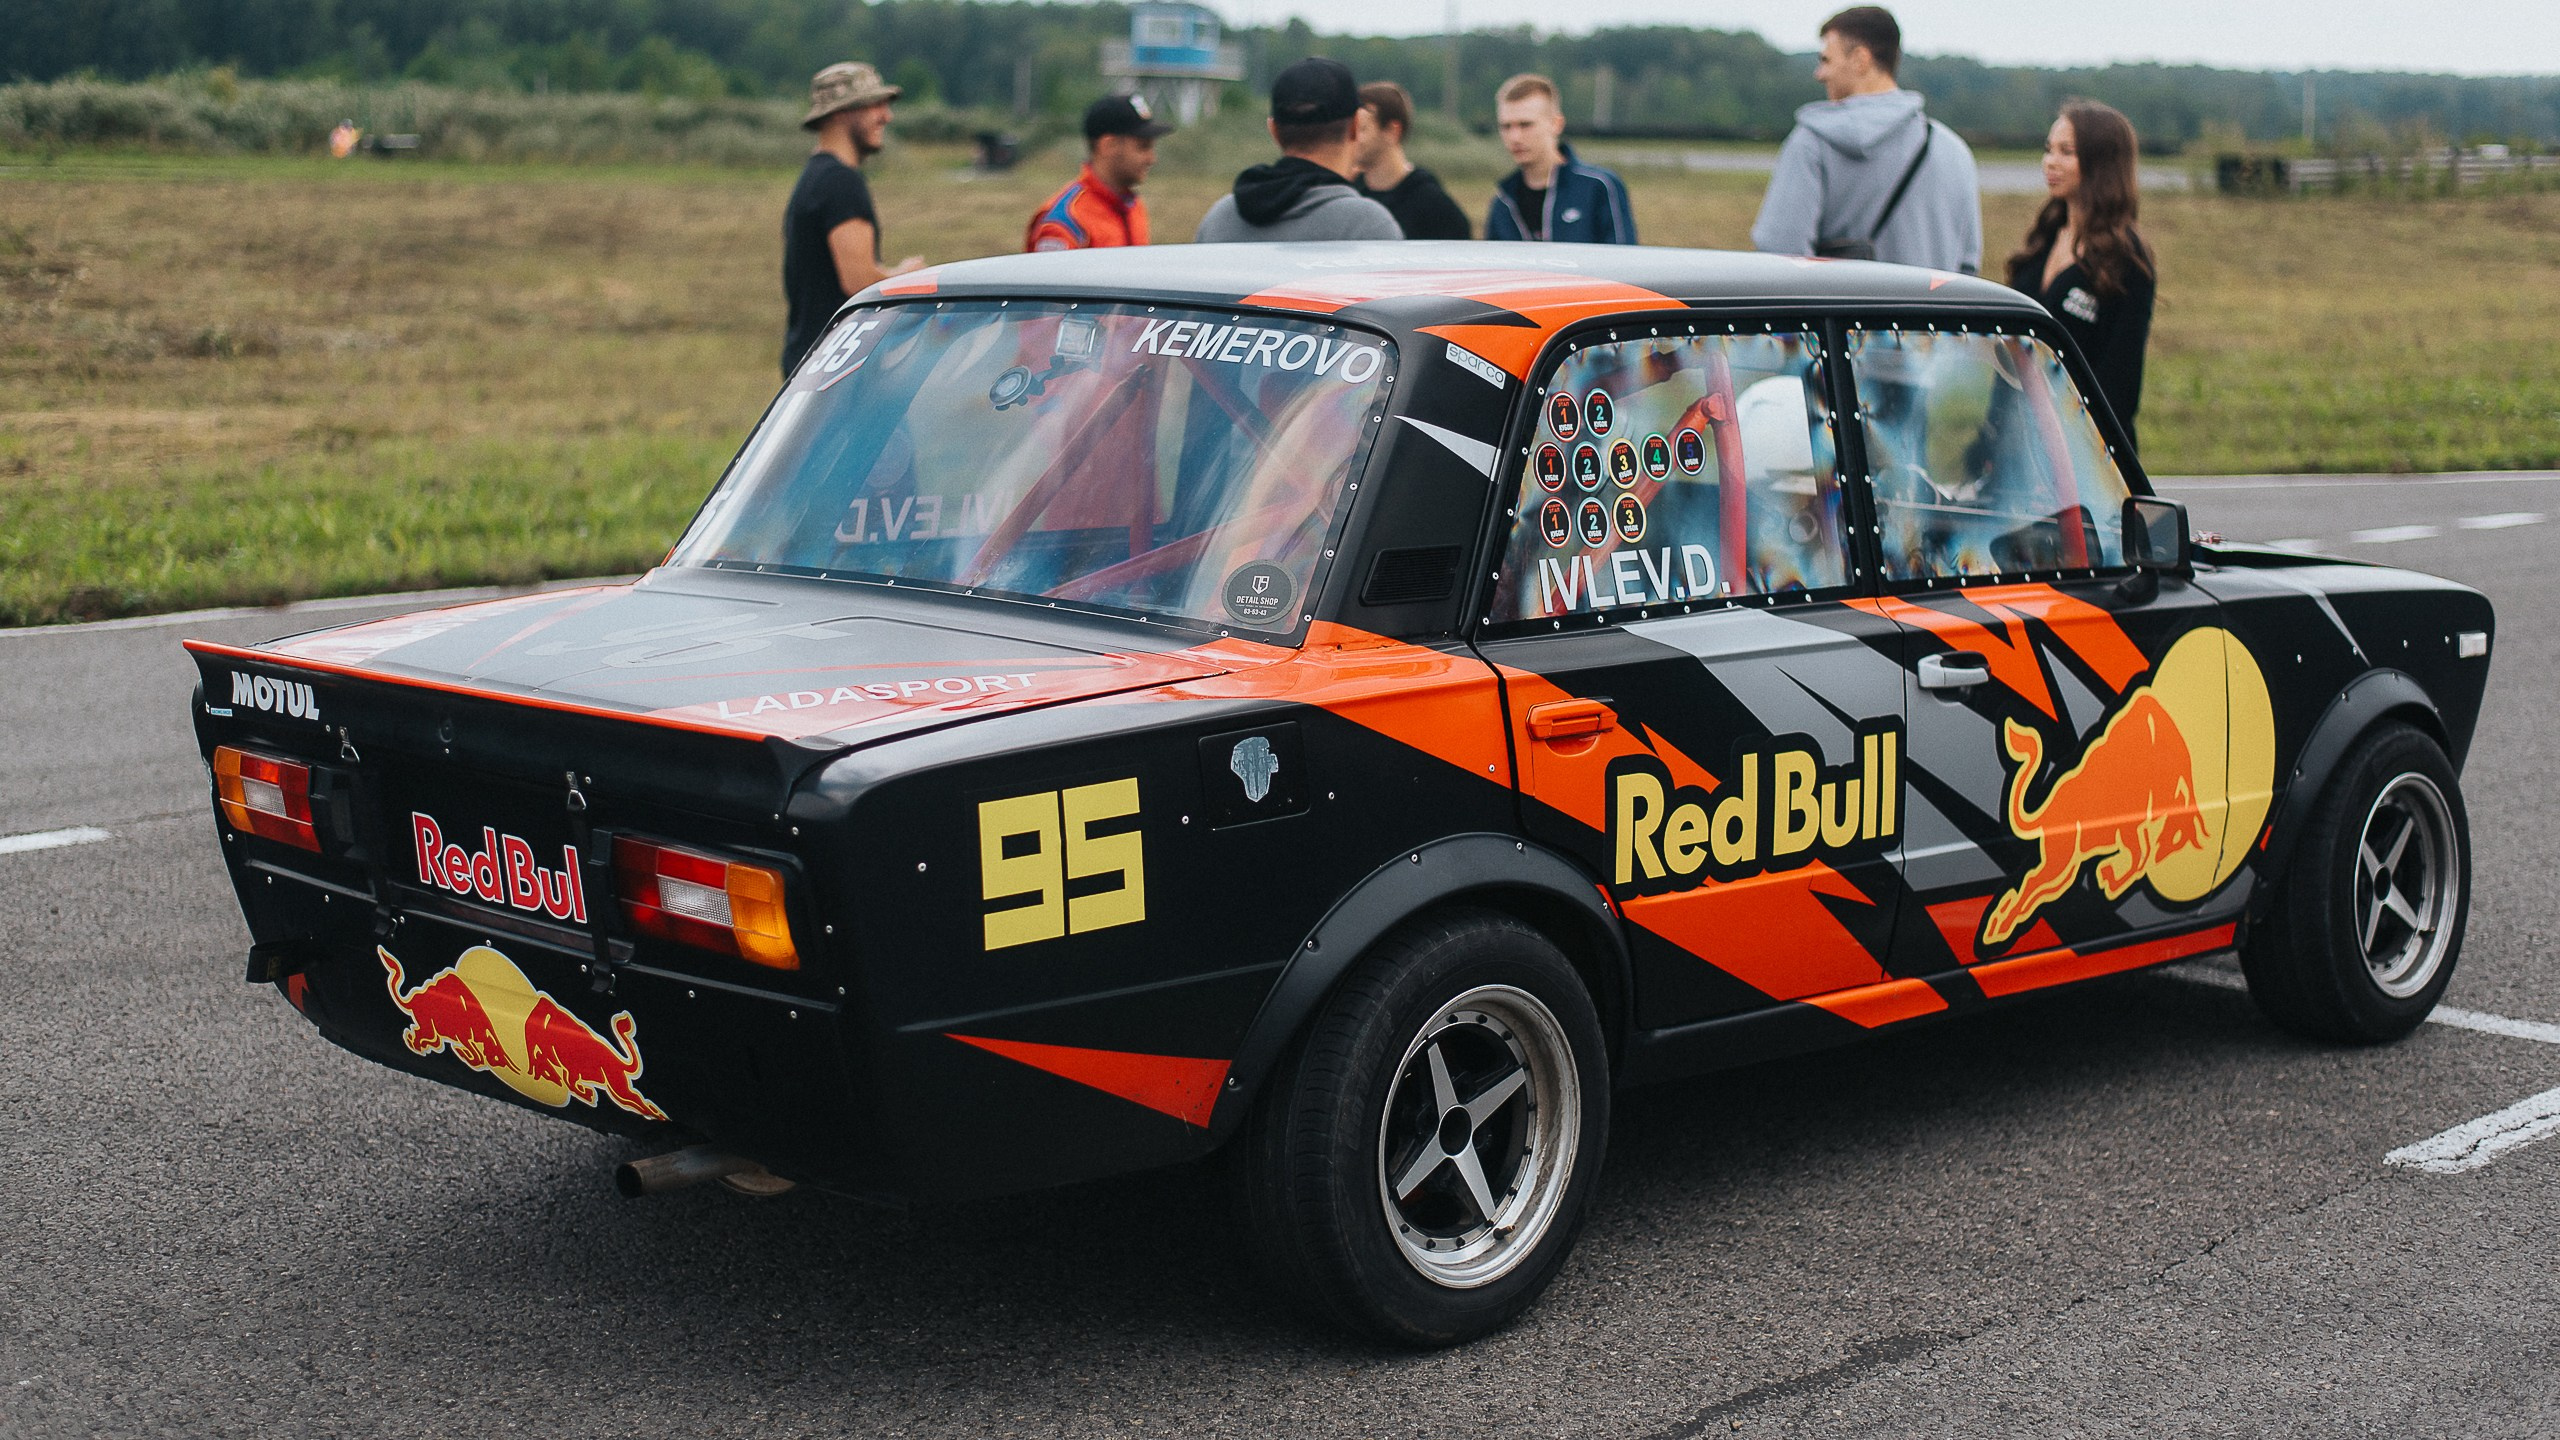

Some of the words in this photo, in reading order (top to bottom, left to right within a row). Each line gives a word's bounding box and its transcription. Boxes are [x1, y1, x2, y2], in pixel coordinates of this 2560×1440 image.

[806, 320, 881, 376] 95
[1131, 318, 1382, 384] KEMEROVO
[1449, 346, 1504, 383] sparco
[1560, 407, 1568, 424] 1
[1595, 405, 1604, 421] 2
[1653, 448, 1662, 464] 4
[1686, 443, 1694, 458] 5
[1546, 458, 1554, 474] 1
[1583, 458, 1592, 474] 2
[1619, 454, 1629, 471] 3
[1551, 514, 1559, 529] 1
[1589, 514, 1598, 530] 2
[1625, 509, 1635, 525] 3
[1538, 543, 1731, 614] IVLEV.D.
[1235, 595, 1260, 604] DETAIL
[1260, 597, 1279, 606] SHOP
[231, 670, 320, 721] MOTUL
[717, 672, 1037, 719] LADASPORT
[1615, 752, 1758, 885] Red
[1772, 731, 1897, 857] Bull
[412, 811, 504, 904] Red
[502, 833, 588, 924] Bul
[978, 776, 1146, 951] 95
